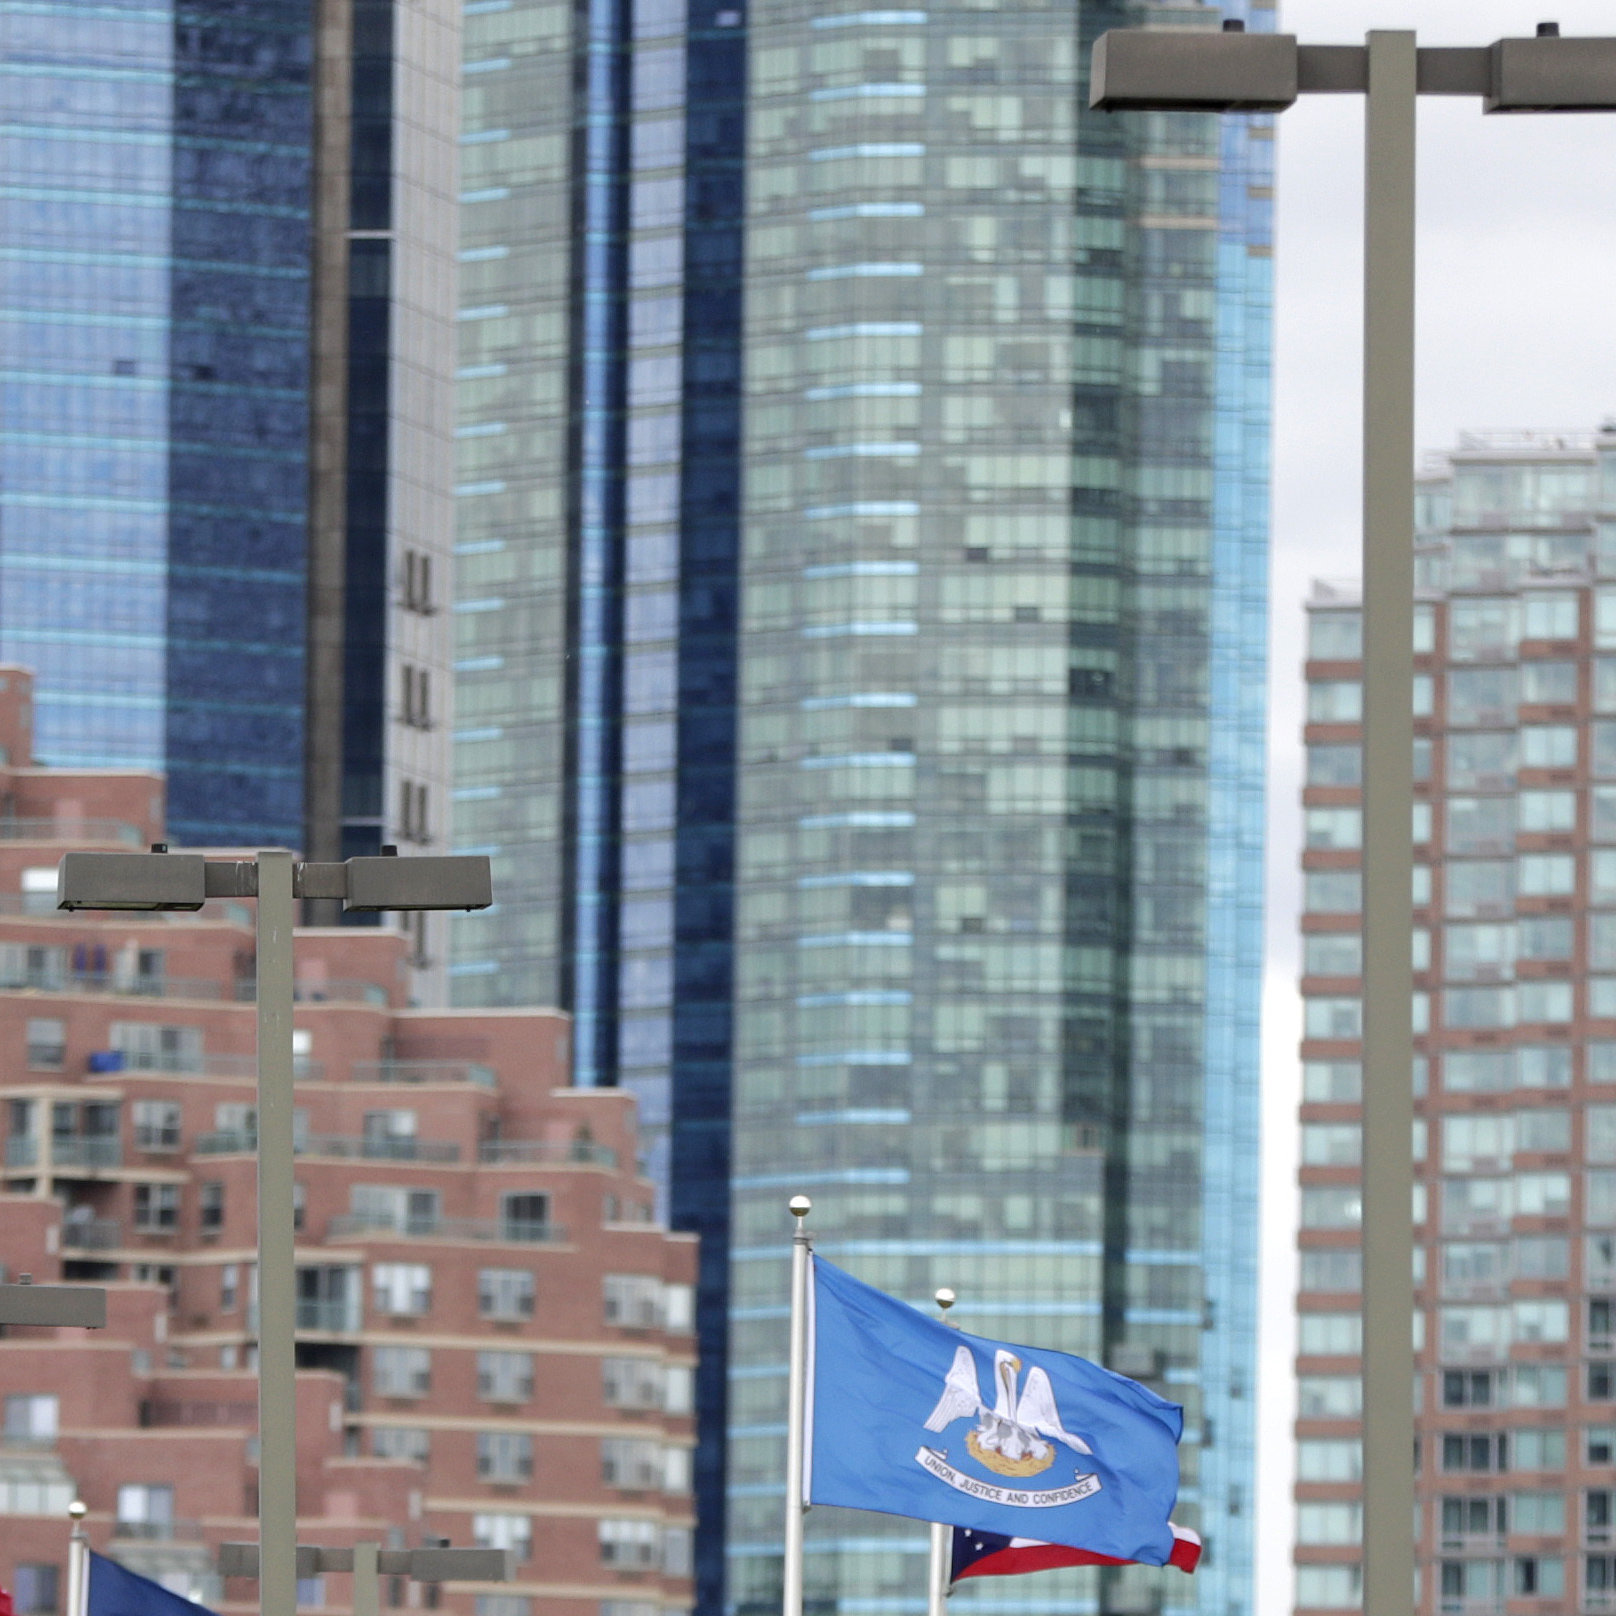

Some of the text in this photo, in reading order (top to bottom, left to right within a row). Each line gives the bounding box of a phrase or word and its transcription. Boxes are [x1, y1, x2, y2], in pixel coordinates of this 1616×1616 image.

[924, 1455, 1093, 1505] UNION, JUSTICE AND CONFIDENCE
